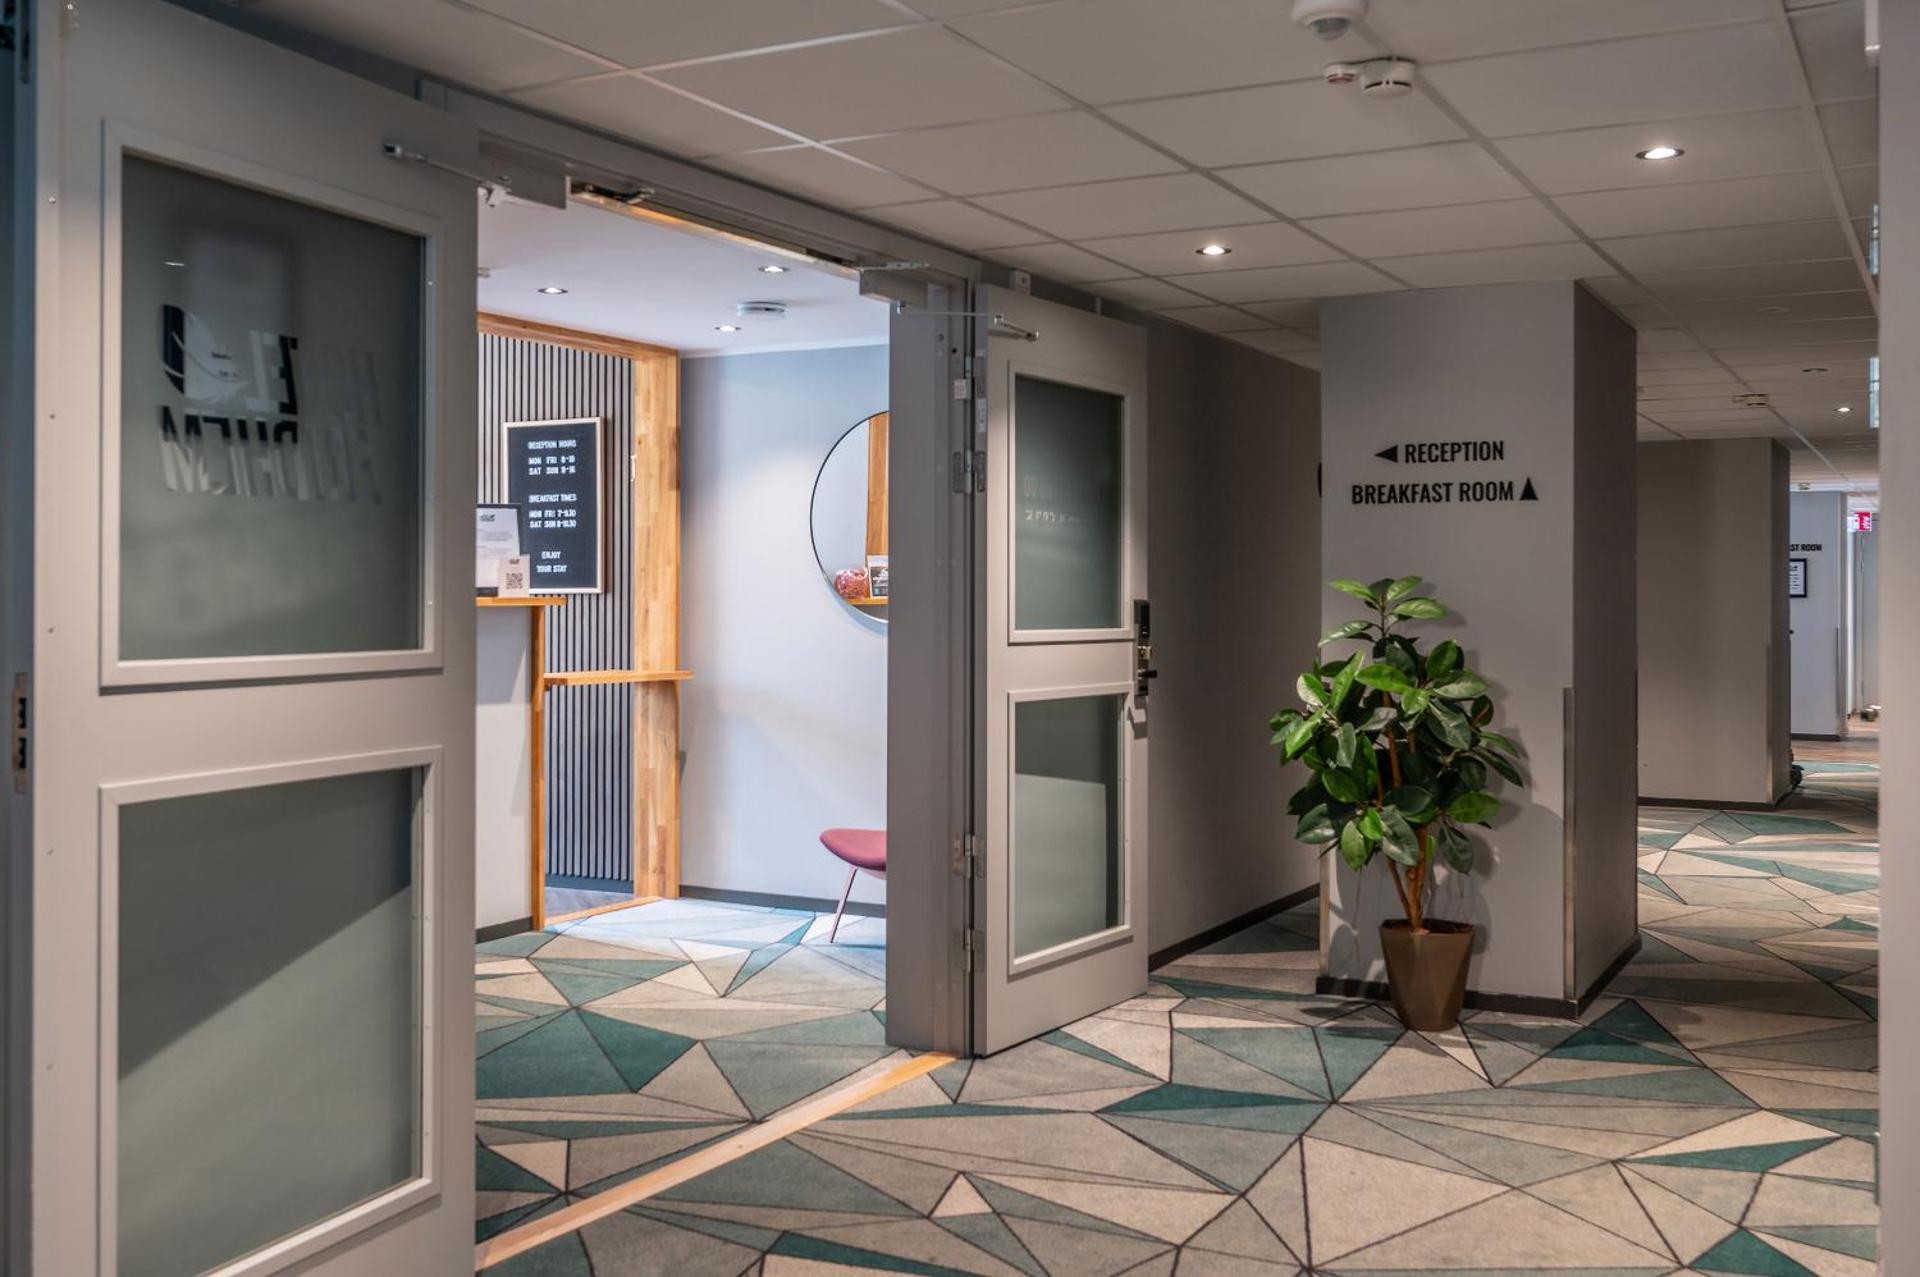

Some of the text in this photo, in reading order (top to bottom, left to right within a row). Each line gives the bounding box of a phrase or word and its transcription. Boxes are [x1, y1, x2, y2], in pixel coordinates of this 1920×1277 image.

[528, 439, 577, 450] RECEPTION HOURS
[1405, 440, 1504, 464] RECEPTION
[528, 456, 542, 465] MON
[546, 456, 557, 464] FRI
[528, 466, 541, 475] SAT
[546, 466, 559, 475] SUN
[1352, 481, 1514, 505] BREAKFAST ROOM
[528, 493, 577, 503] BREAKFAST TIMES
[528, 510, 542, 519] MON
[529, 520, 542, 528] SAT
[544, 520, 556, 528] SUN
[1801, 543, 1822, 552] ROOM
[541, 550, 561, 559] ENJOY
[536, 564, 567, 573] YOUR STAY
